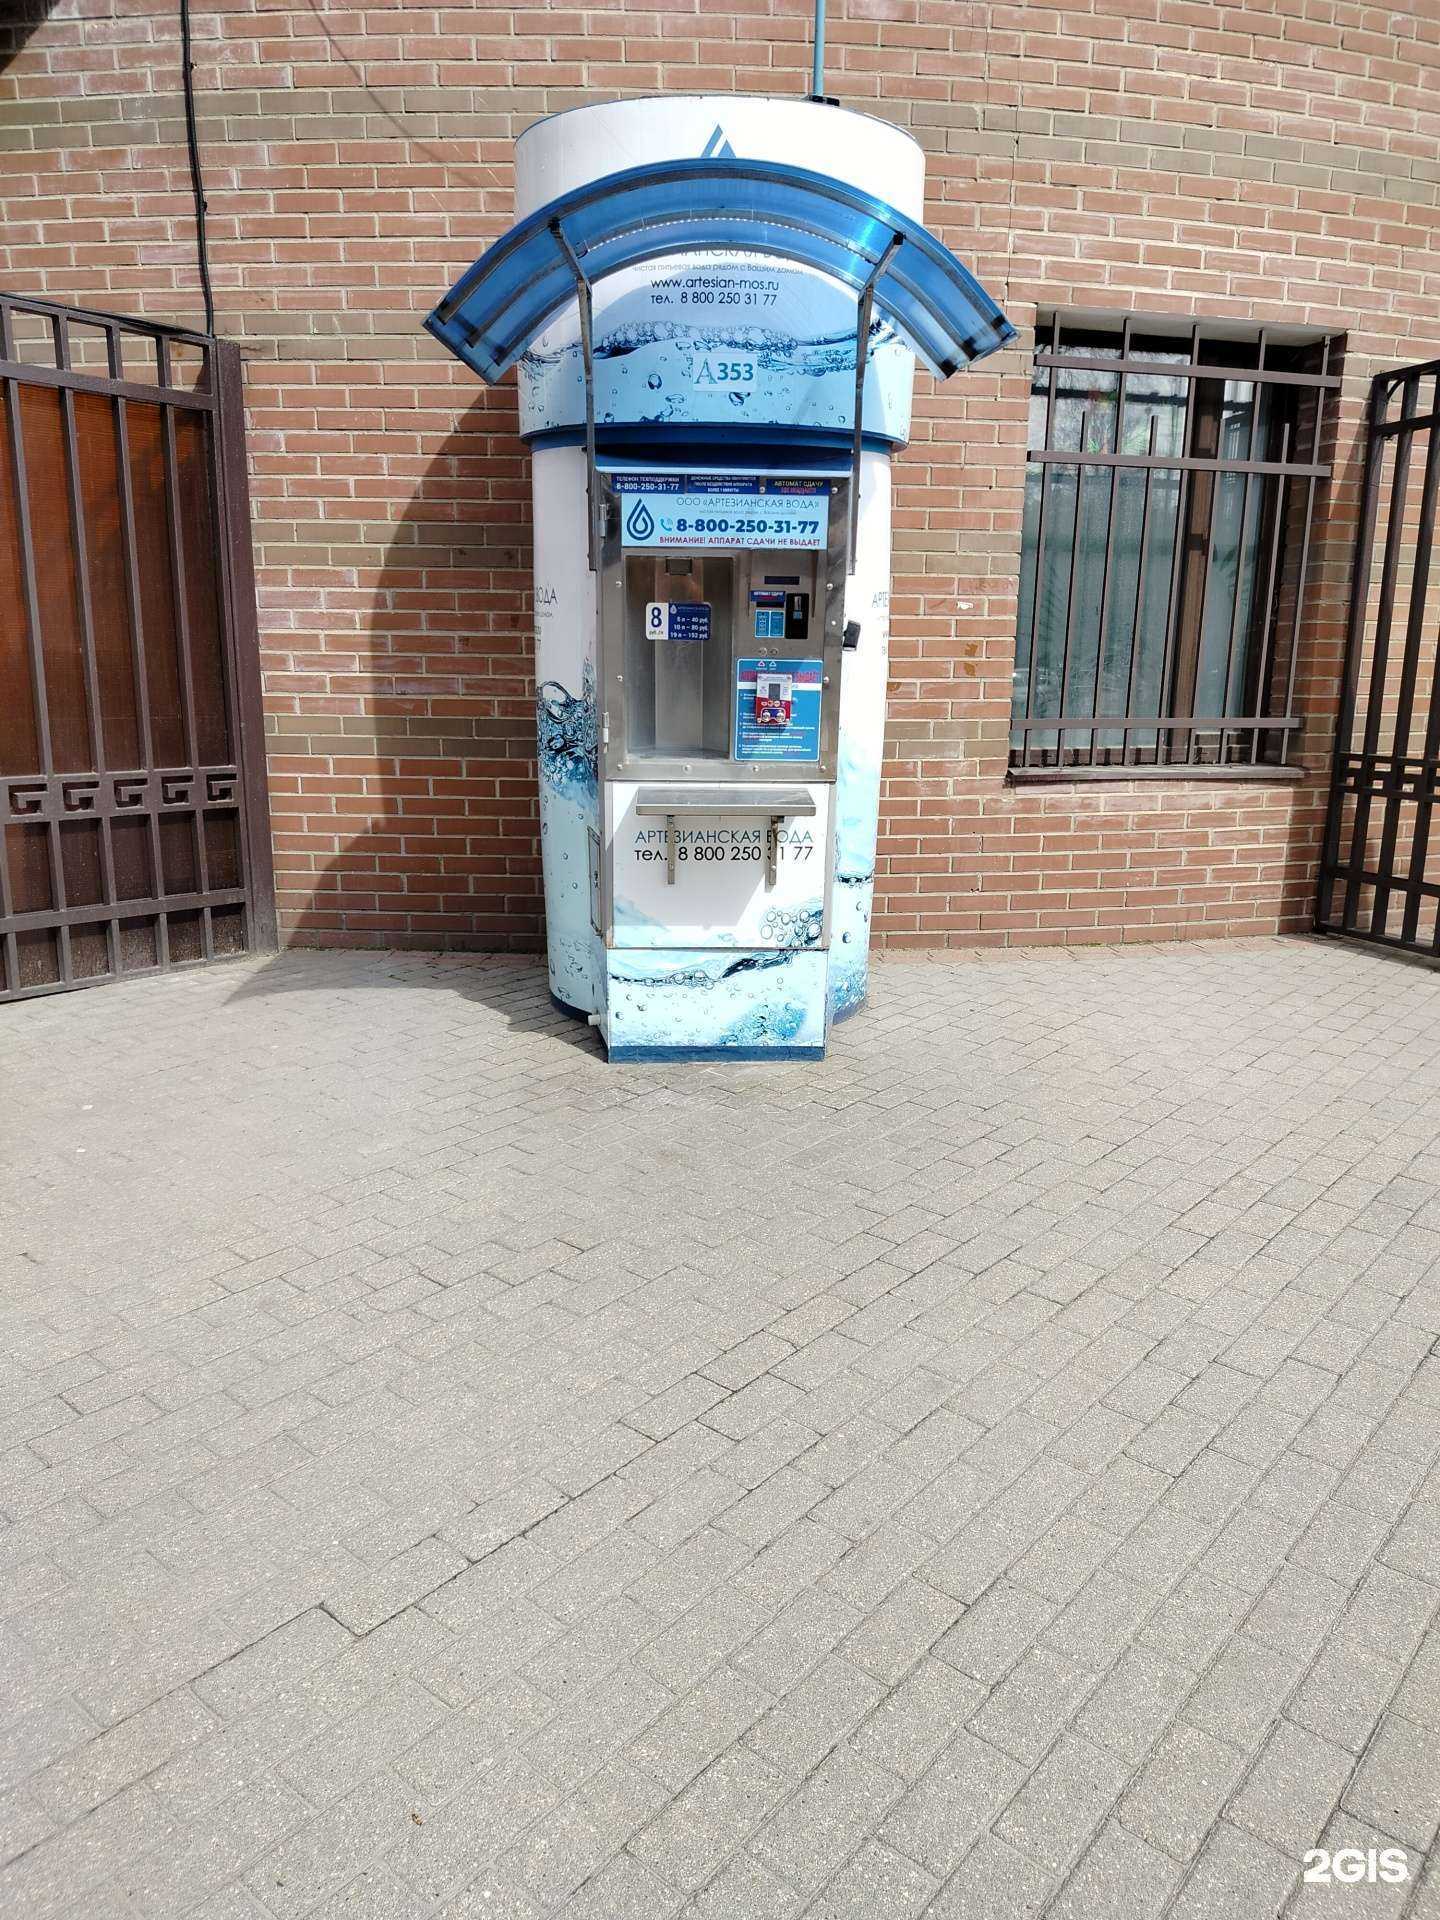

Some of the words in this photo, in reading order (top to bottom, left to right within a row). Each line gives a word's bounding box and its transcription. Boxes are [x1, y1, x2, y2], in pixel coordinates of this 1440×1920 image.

[651, 276, 779, 291] www.artesian-mos.ru
[651, 295, 674, 304] тел.
[680, 292, 688, 304] 8
[692, 292, 714, 304] 800
[718, 293, 741, 305] 250
[744, 293, 757, 305] 31
[763, 294, 777, 306] 77
[616, 482, 680, 491] 8-800-250-31-77
[677, 497, 700, 506] ООО
[703, 498, 783, 508] «АРТЕЗИАНСКАЯ
[676, 518, 819, 534] 8-800-250-31-77
[659, 536, 706, 544] ВНИМАНИЕ!
[708, 537, 745, 545] АППАРАТ
[747, 538, 775, 546] СДАЧИ
[651, 607, 663, 628] 8
[634, 830, 761, 844] АРТЕЗИАНСКАЯ
[634, 849, 668, 861] тел.
[678, 846, 688, 861] 8
[694, 846, 725, 861] 800
[730, 846, 761, 861] 250
[793, 846, 813, 861] 77
